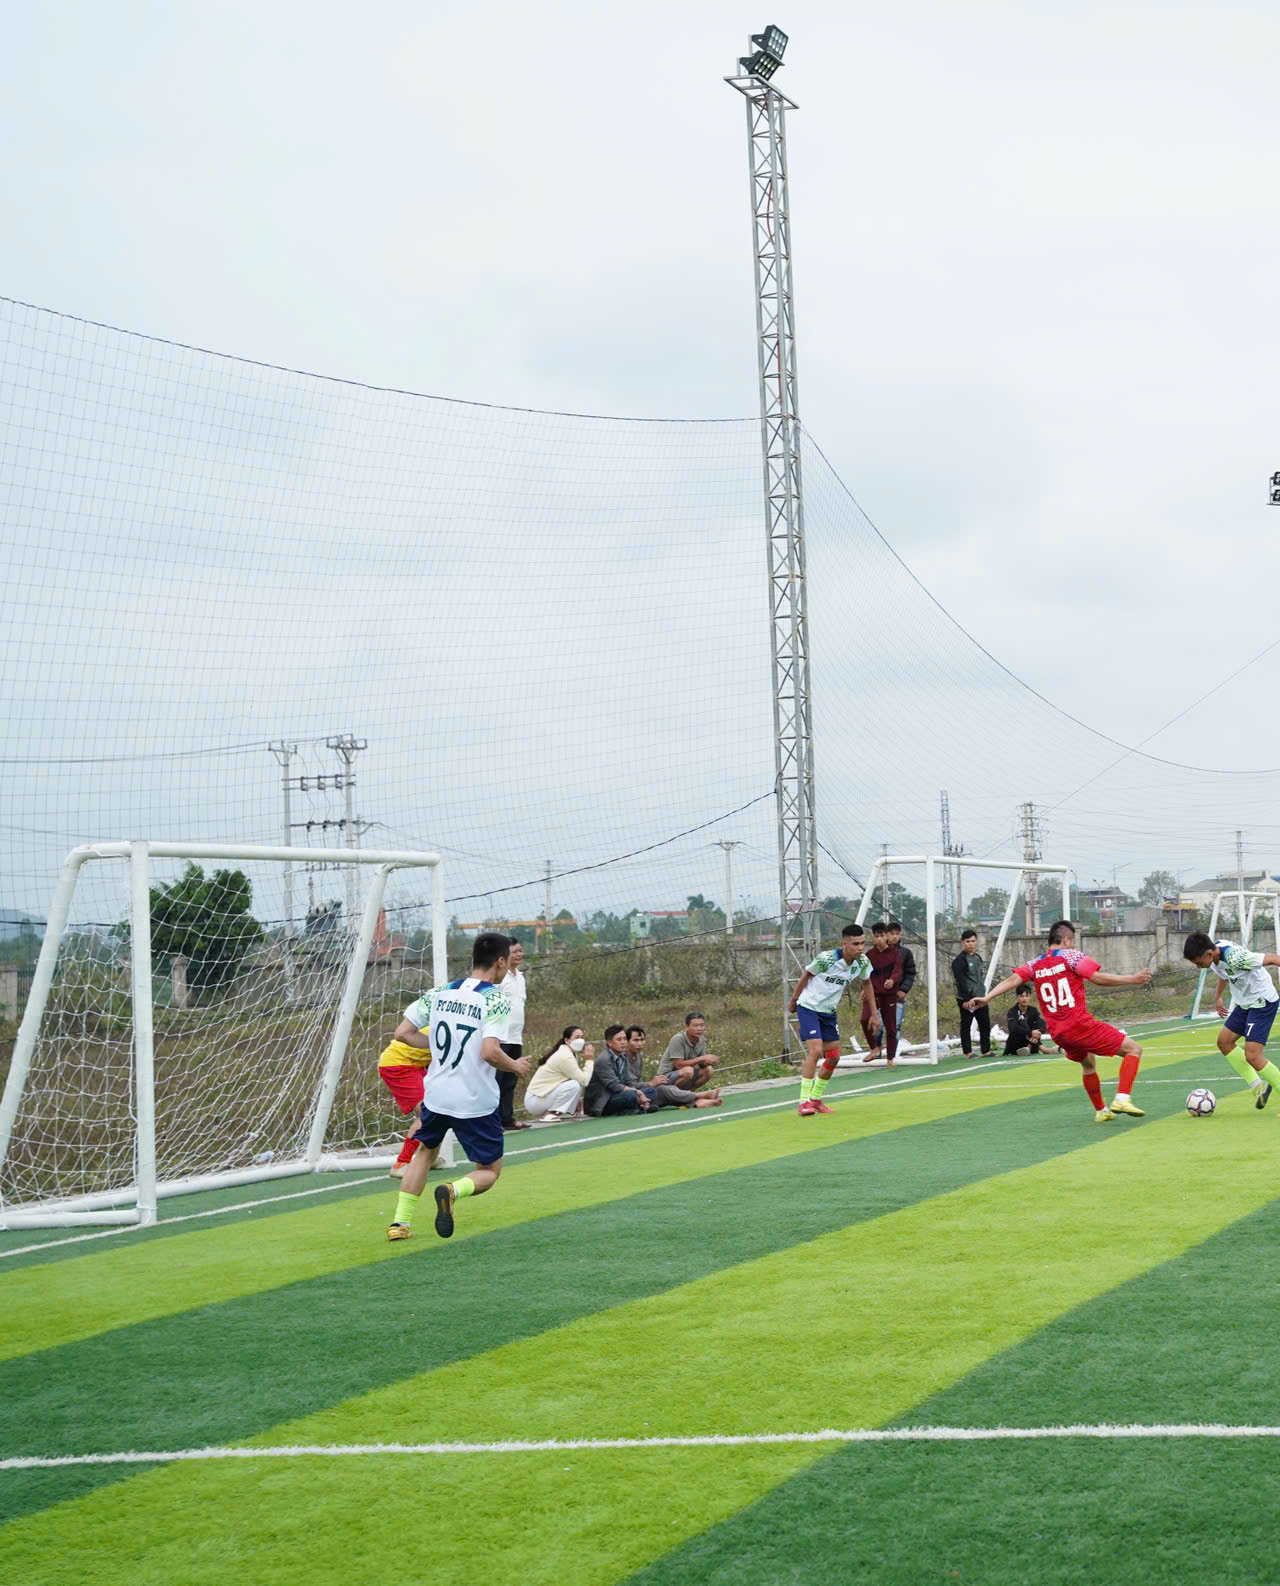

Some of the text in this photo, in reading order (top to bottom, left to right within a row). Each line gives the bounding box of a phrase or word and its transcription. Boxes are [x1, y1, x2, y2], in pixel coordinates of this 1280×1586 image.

[436, 999, 447, 1011] FC
[1040, 977, 1076, 1013] 94
[1246, 1023, 1255, 1037] 7
[435, 1020, 478, 1070] 97
